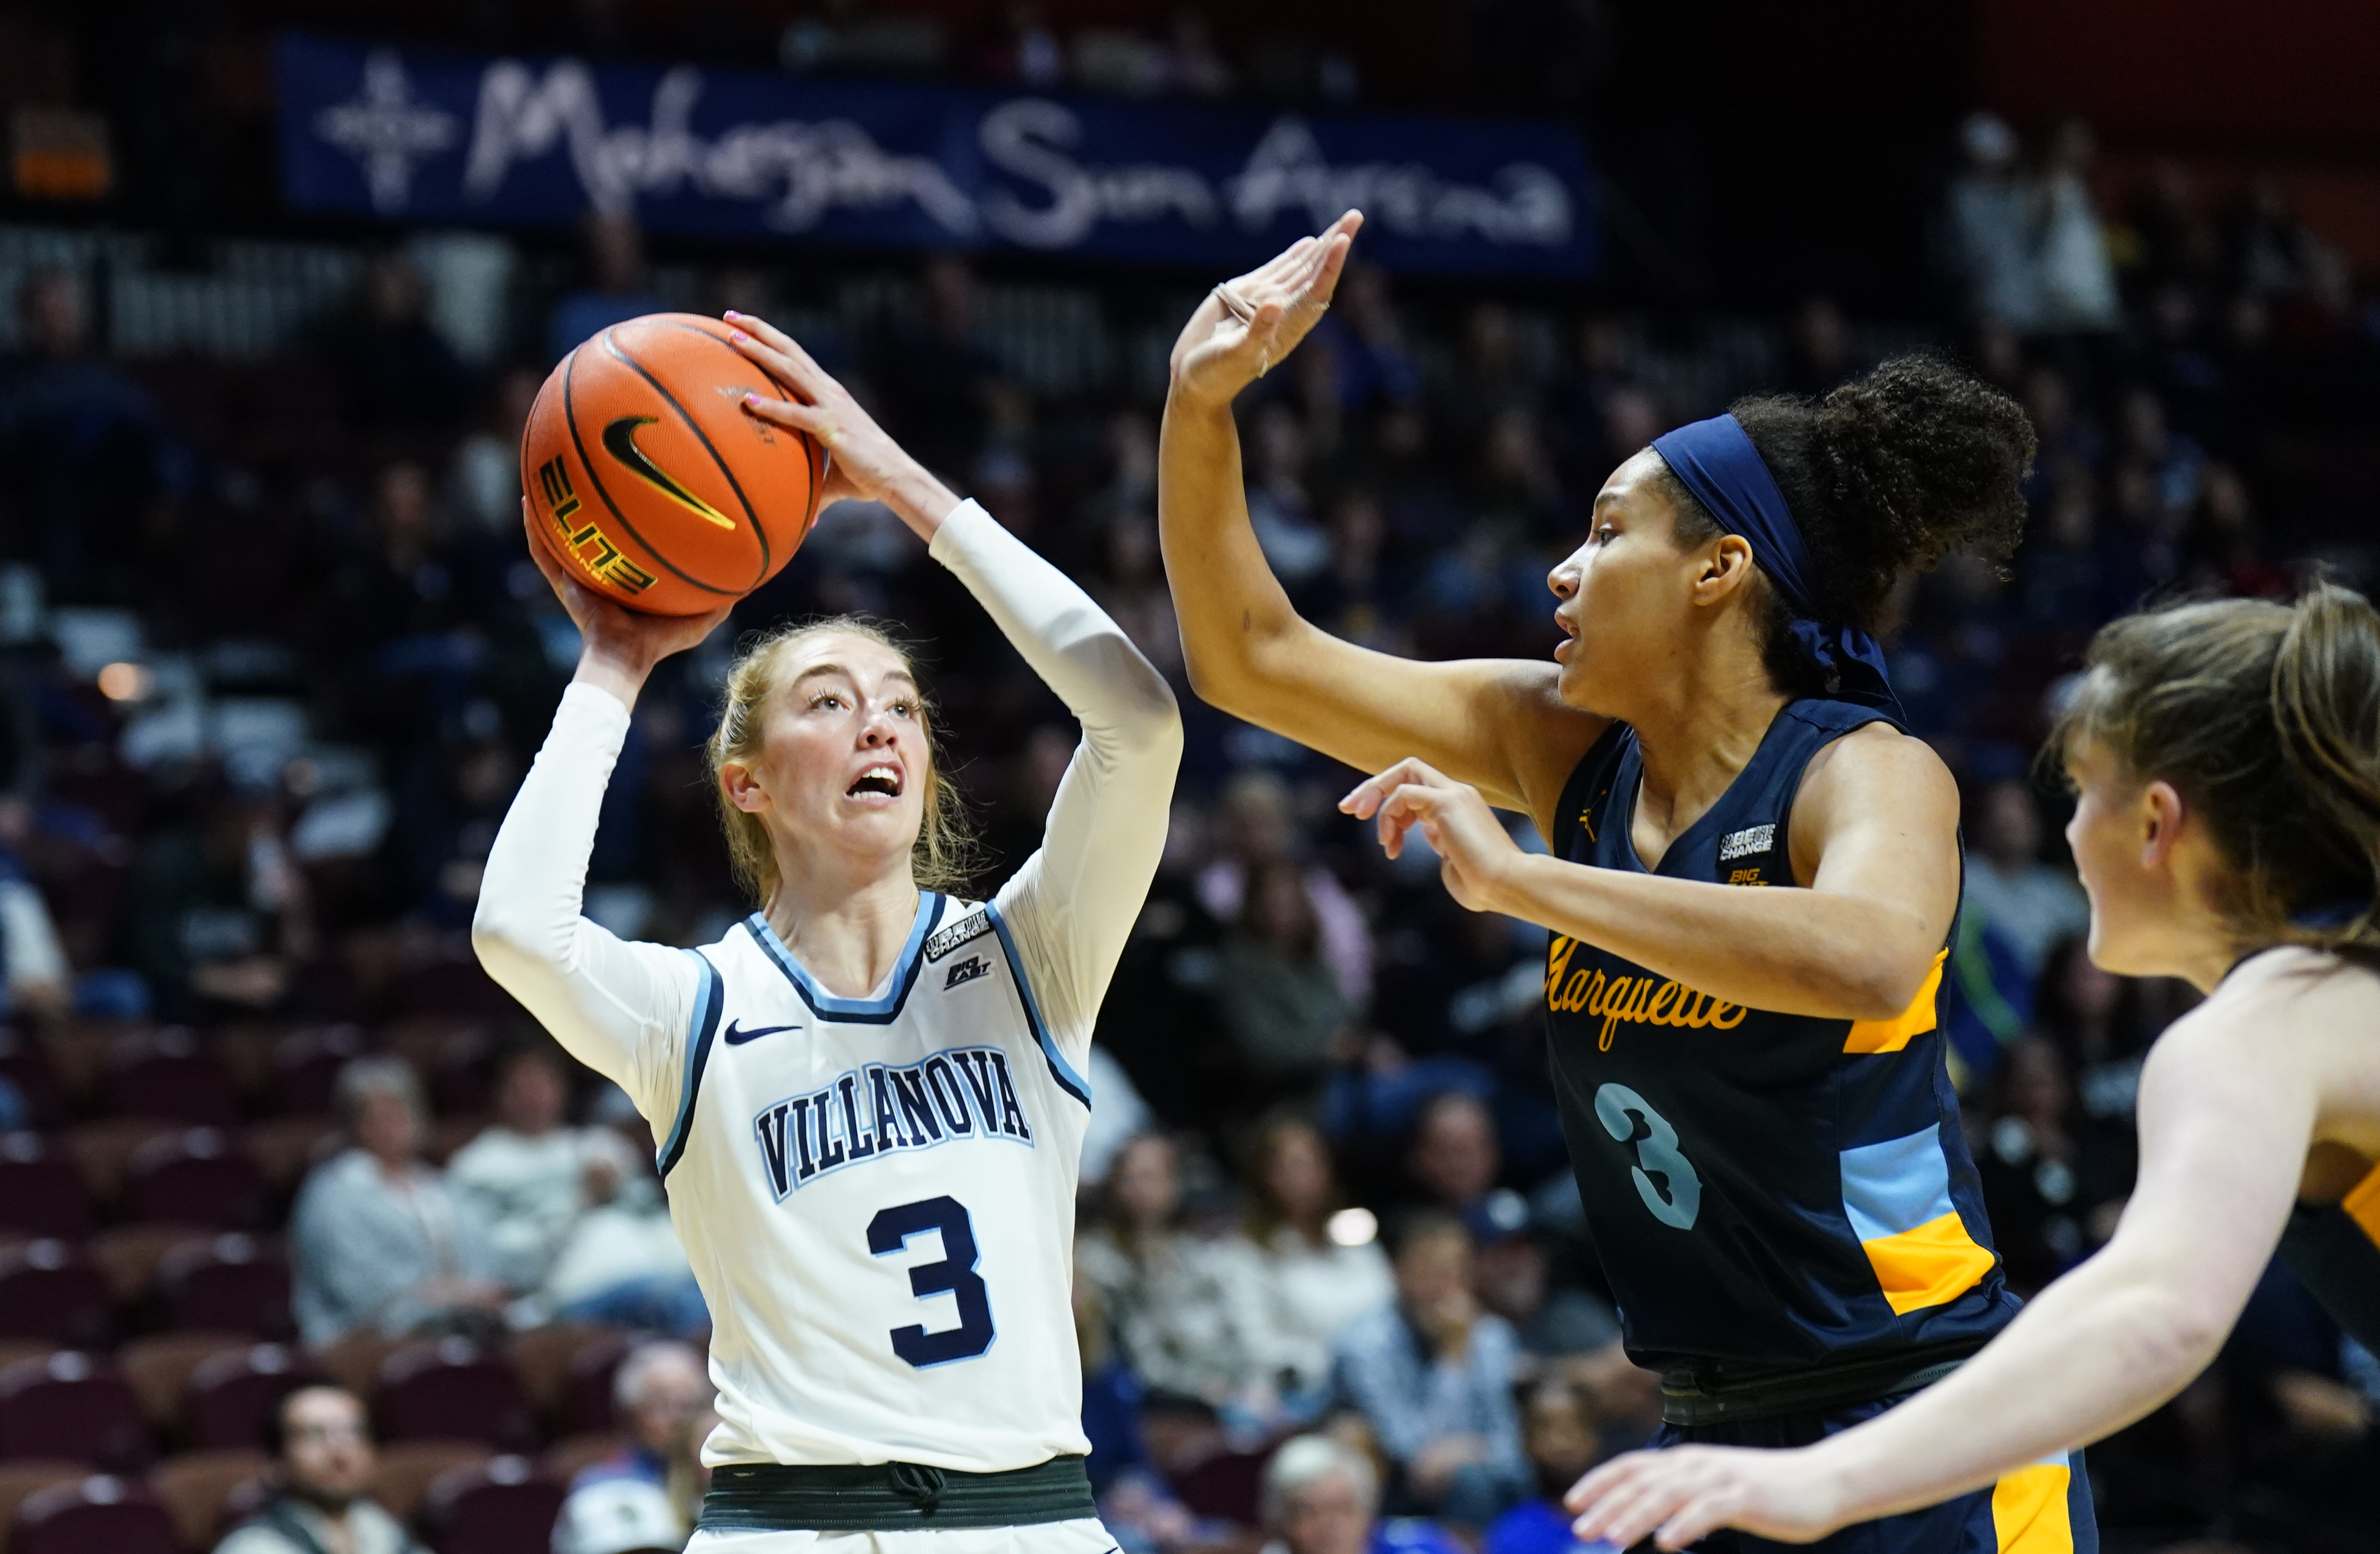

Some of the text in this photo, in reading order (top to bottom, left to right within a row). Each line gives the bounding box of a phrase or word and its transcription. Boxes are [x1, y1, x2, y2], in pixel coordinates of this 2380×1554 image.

[461, 58, 1571, 249] Mohegan Sun Arena
[540, 454, 657, 595] ELITE
[1719, 839, 1773, 861] CHANGE
[1730, 868, 1760, 882] BIG
[930, 921, 990, 959] CHANGE
[948, 956, 979, 974] BIG
[754, 1047, 1033, 1203] VILLANOVA
[1594, 1082, 1703, 1231] 3
[867, 1195, 997, 1369] 3
